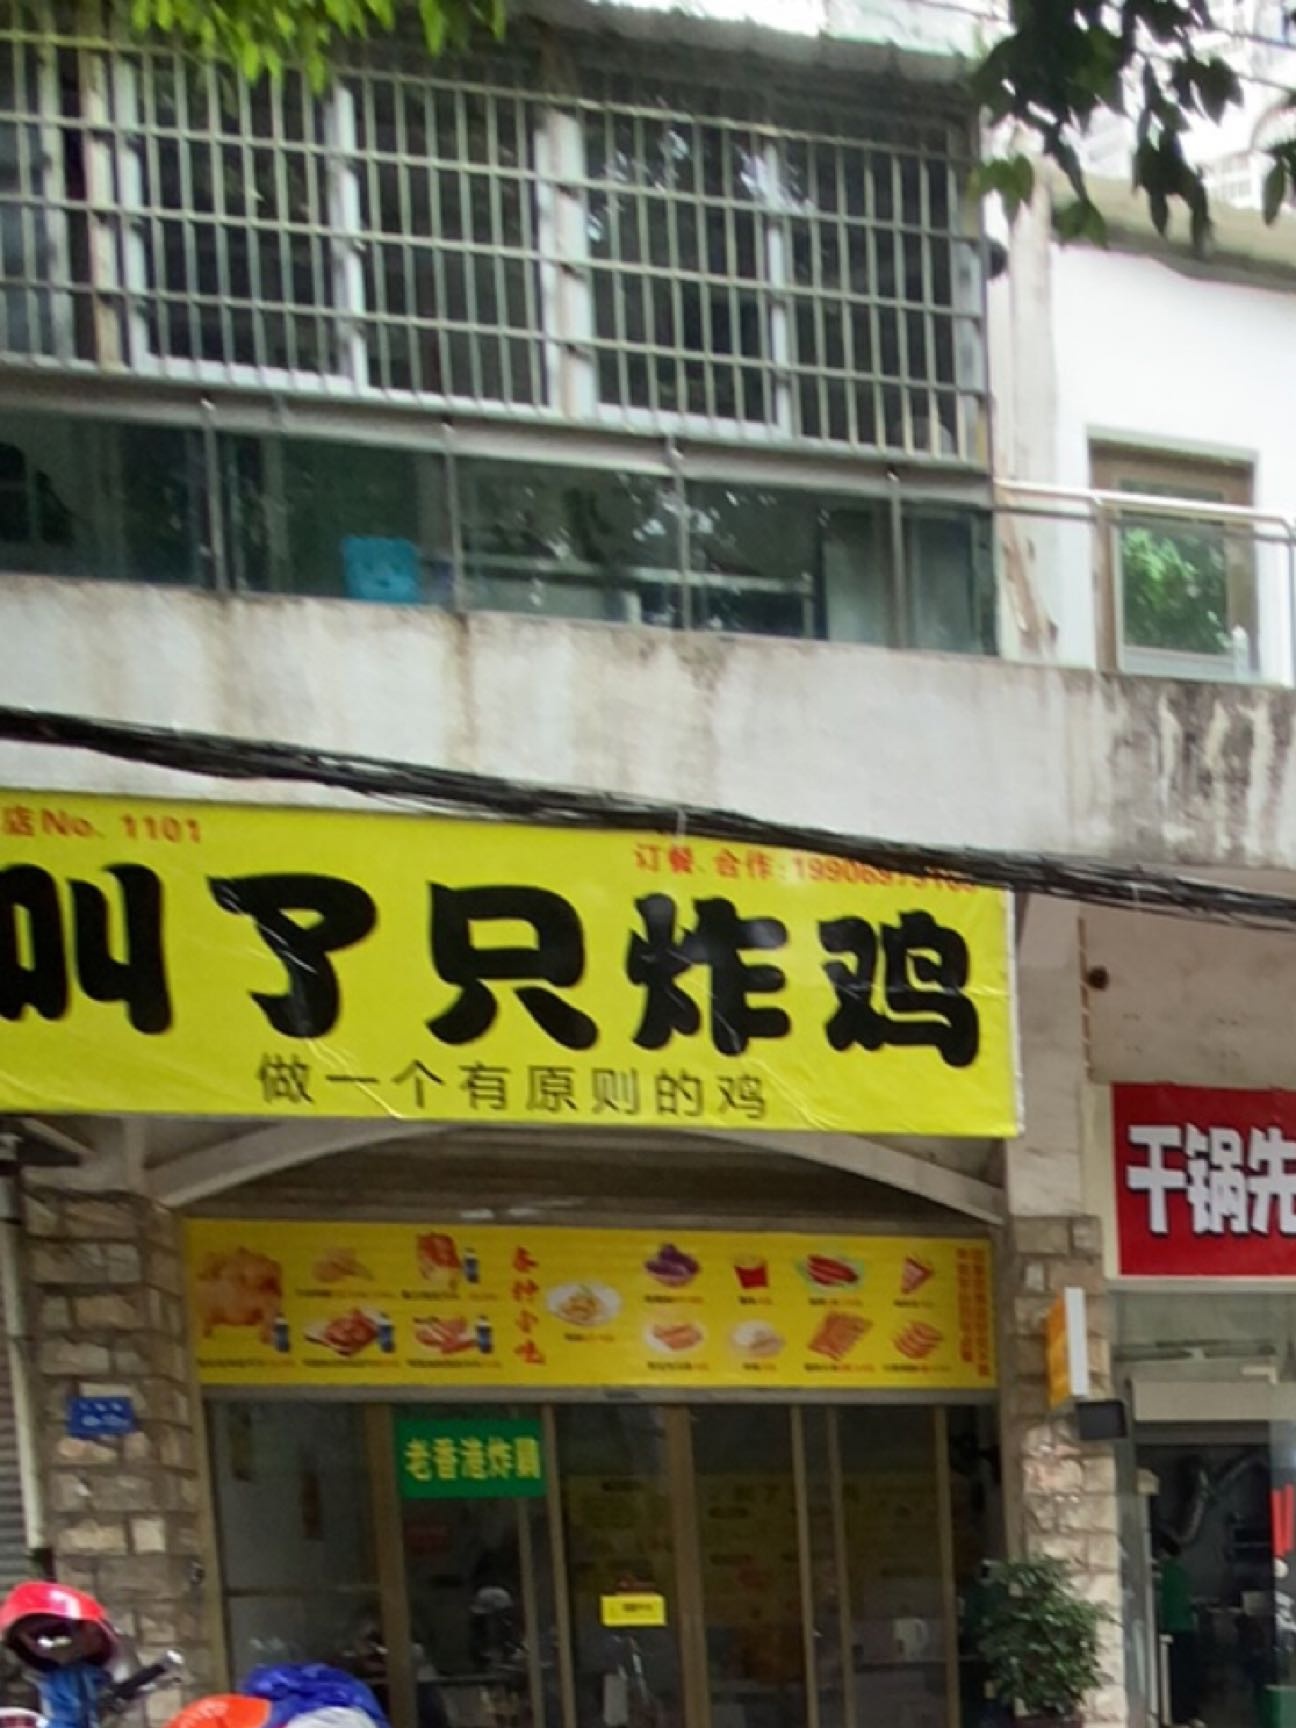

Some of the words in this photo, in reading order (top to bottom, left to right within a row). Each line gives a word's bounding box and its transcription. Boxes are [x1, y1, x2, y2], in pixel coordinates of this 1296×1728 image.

[121, 813, 203, 844] 1101
[0, 863, 979, 1067] 叫了只炸鸡
[257, 1053, 767, 1119] 做一个有原则的鸡
